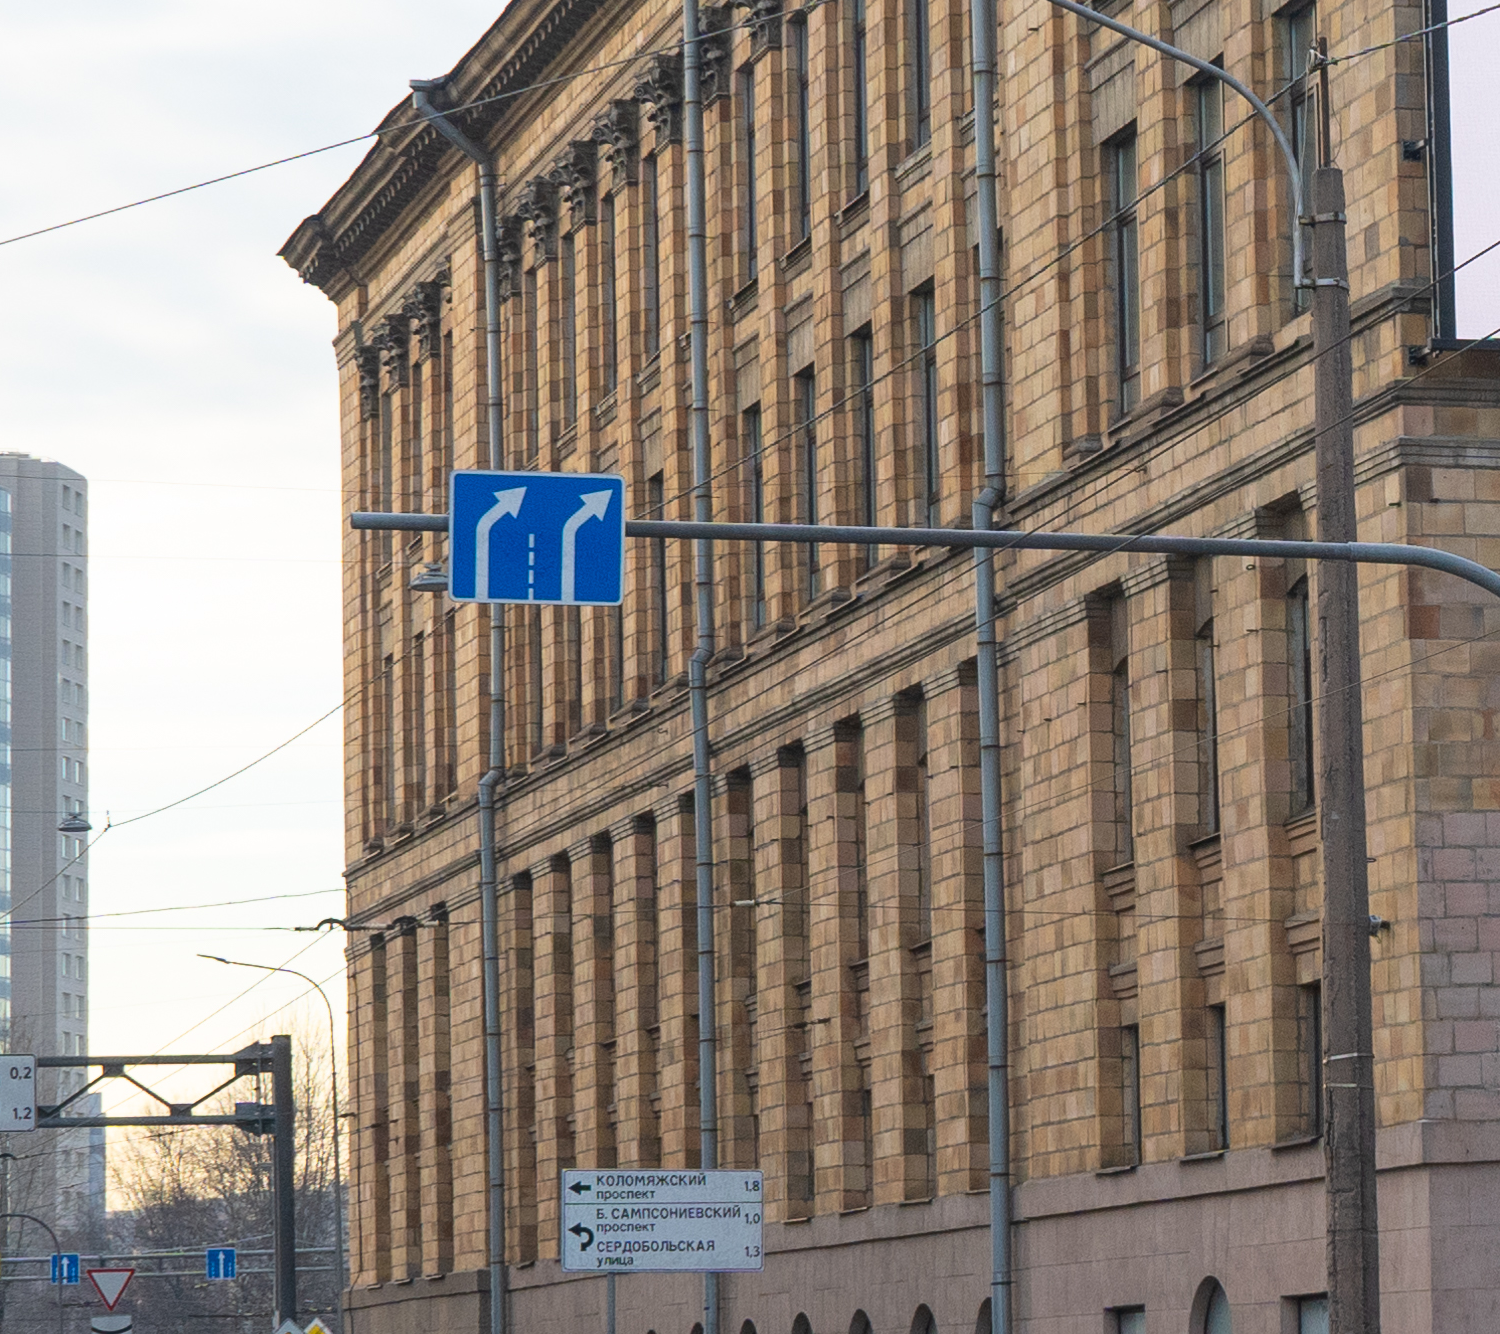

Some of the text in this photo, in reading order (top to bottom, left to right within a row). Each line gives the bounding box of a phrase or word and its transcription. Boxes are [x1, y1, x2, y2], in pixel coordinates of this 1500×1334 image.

[9, 1067, 32, 1080] 0,2
[12, 1107, 32, 1121] 1,2
[596, 1173, 707, 1187] КОЛОМЯЖСКИЙ
[744, 1180, 761, 1193] 1,8
[596, 1190, 655, 1201] проспект
[596, 1205, 741, 1220] Б. САМПСОНИЕВСКИЙ
[744, 1213, 761, 1225] 1,0
[596, 1223, 656, 1234] проспект
[596, 1240, 715, 1253] СЕРДОБОЛЬСКАЯ
[744, 1246, 761, 1258] 1,3
[596, 1256, 634, 1267] улица
